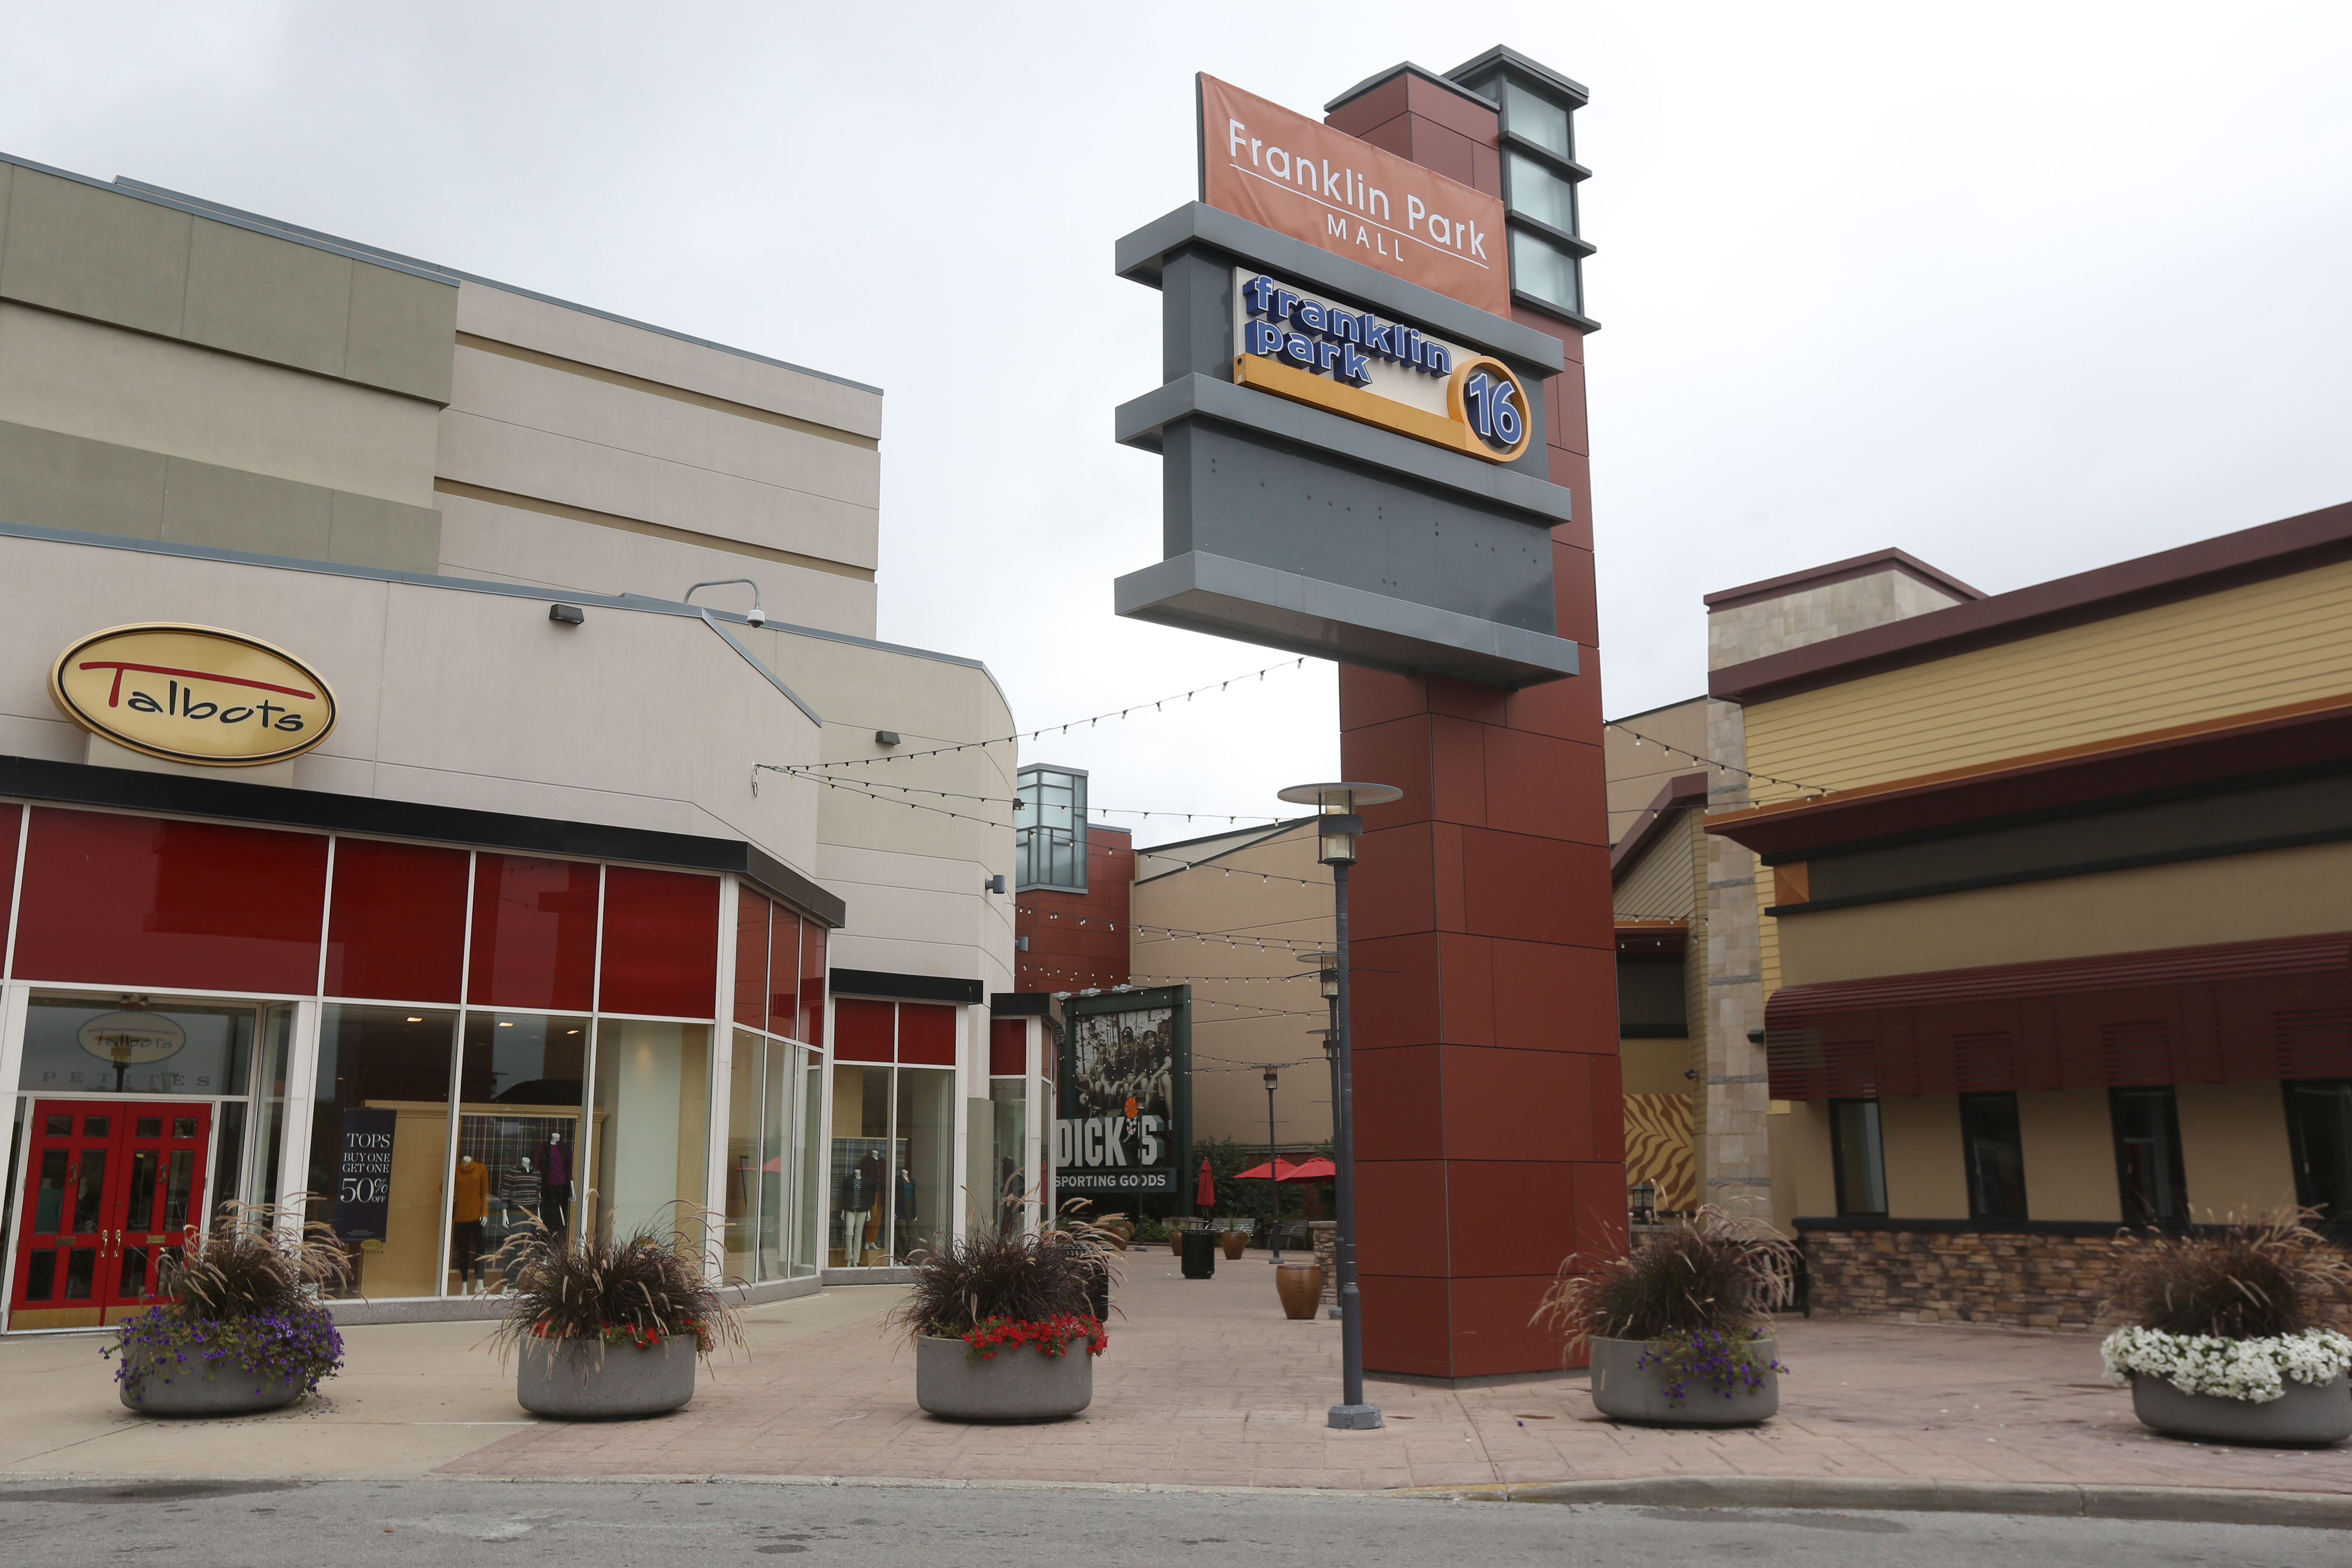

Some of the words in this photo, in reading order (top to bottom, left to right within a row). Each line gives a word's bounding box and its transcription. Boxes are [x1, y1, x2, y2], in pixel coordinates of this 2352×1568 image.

[1228, 118, 1390, 221] Franklin
[1407, 193, 1487, 260] Park
[1327, 213, 1404, 263] MALL
[1245, 274, 1452, 378] franklin
[1246, 318, 1373, 387] park
[1467, 372, 1523, 445] 16
[79, 661, 317, 732] Talbots
[87, 1028, 178, 1048] Talbots
[41, 1071, 211, 1087] PETITES
[343, 1152, 366, 1162] BUY
[367, 1153, 390, 1162] ONE
[347, 1133, 390, 1148] TOPS
[1056, 1115, 1161, 1167] DICK'S
[342, 1163, 365, 1172] GET
[366, 1164, 389, 1173] ONE
[1056, 1175, 1116, 1187] SPORTING
[1120, 1174, 1166, 1187] GOODS
[340, 1178, 388, 1203] 50%
